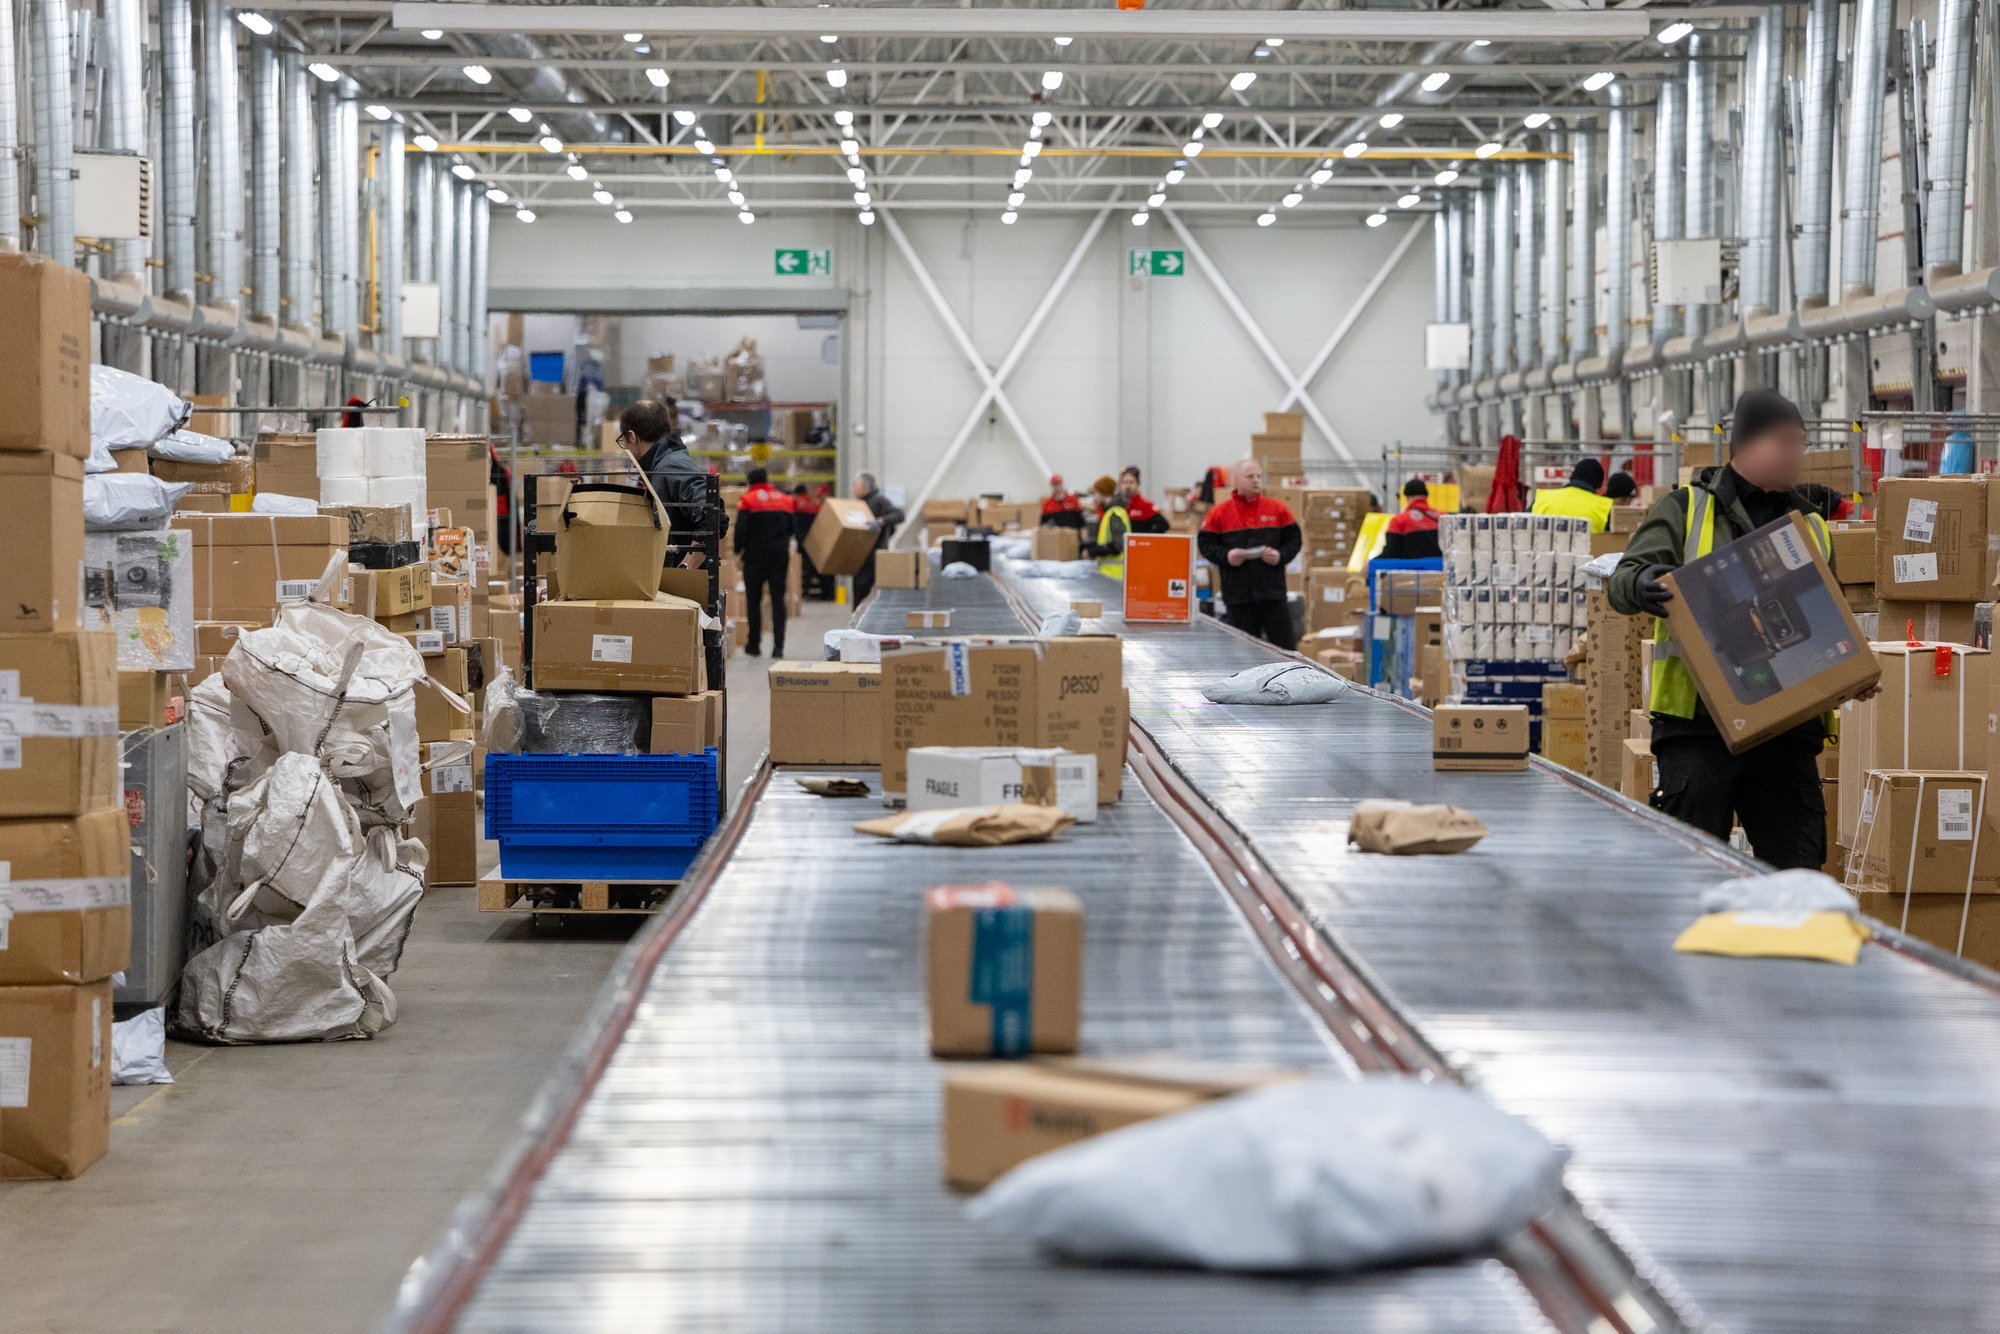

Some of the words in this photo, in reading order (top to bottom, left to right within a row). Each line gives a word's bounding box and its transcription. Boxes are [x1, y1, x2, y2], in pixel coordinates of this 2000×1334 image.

[439, 533, 461, 542] STIHL
[1780, 530, 1802, 565] PHILIPS
[784, 678, 829, 686] Husqvarna
[895, 689, 928, 700] BRAND
[995, 717, 1018, 728] Pairs
[926, 778, 959, 798] FRAGILE
